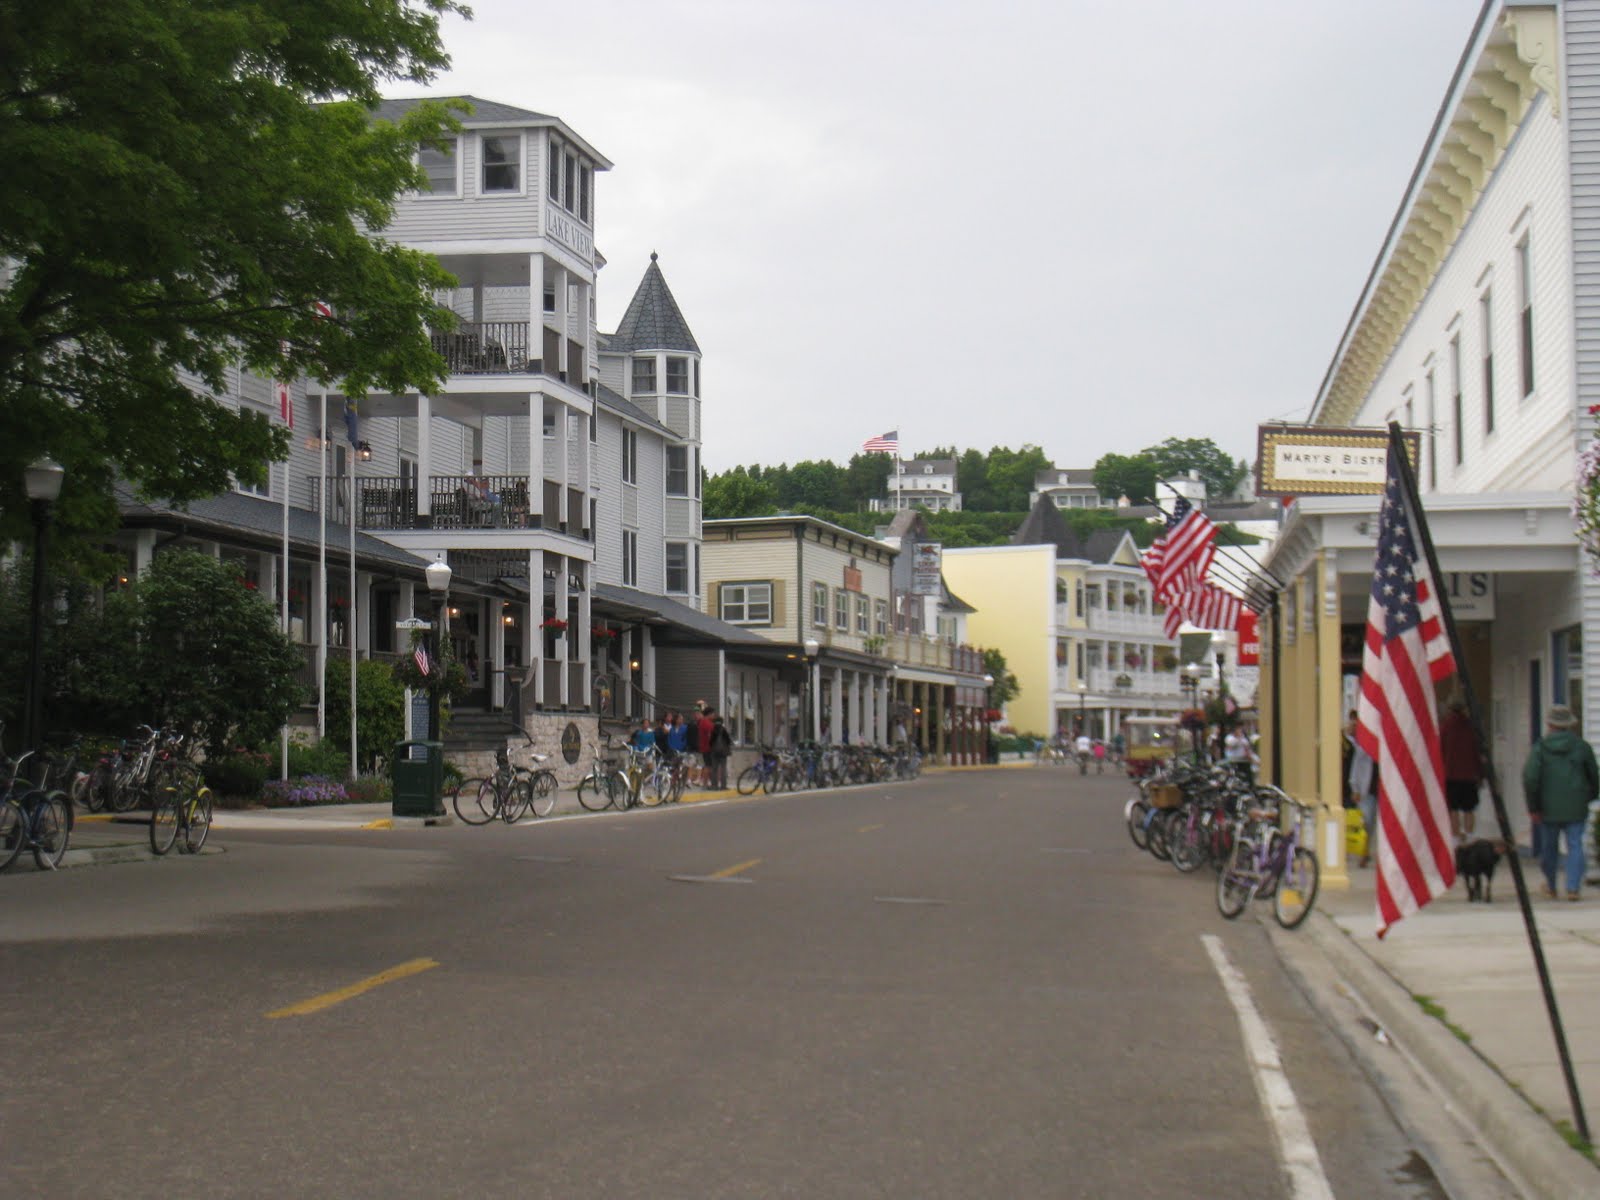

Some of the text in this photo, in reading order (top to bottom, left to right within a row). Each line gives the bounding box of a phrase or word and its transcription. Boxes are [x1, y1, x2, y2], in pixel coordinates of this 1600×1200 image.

[547, 208, 593, 258] LAKE VIEW
[1282, 452, 1385, 466] MARY'S BISTR
